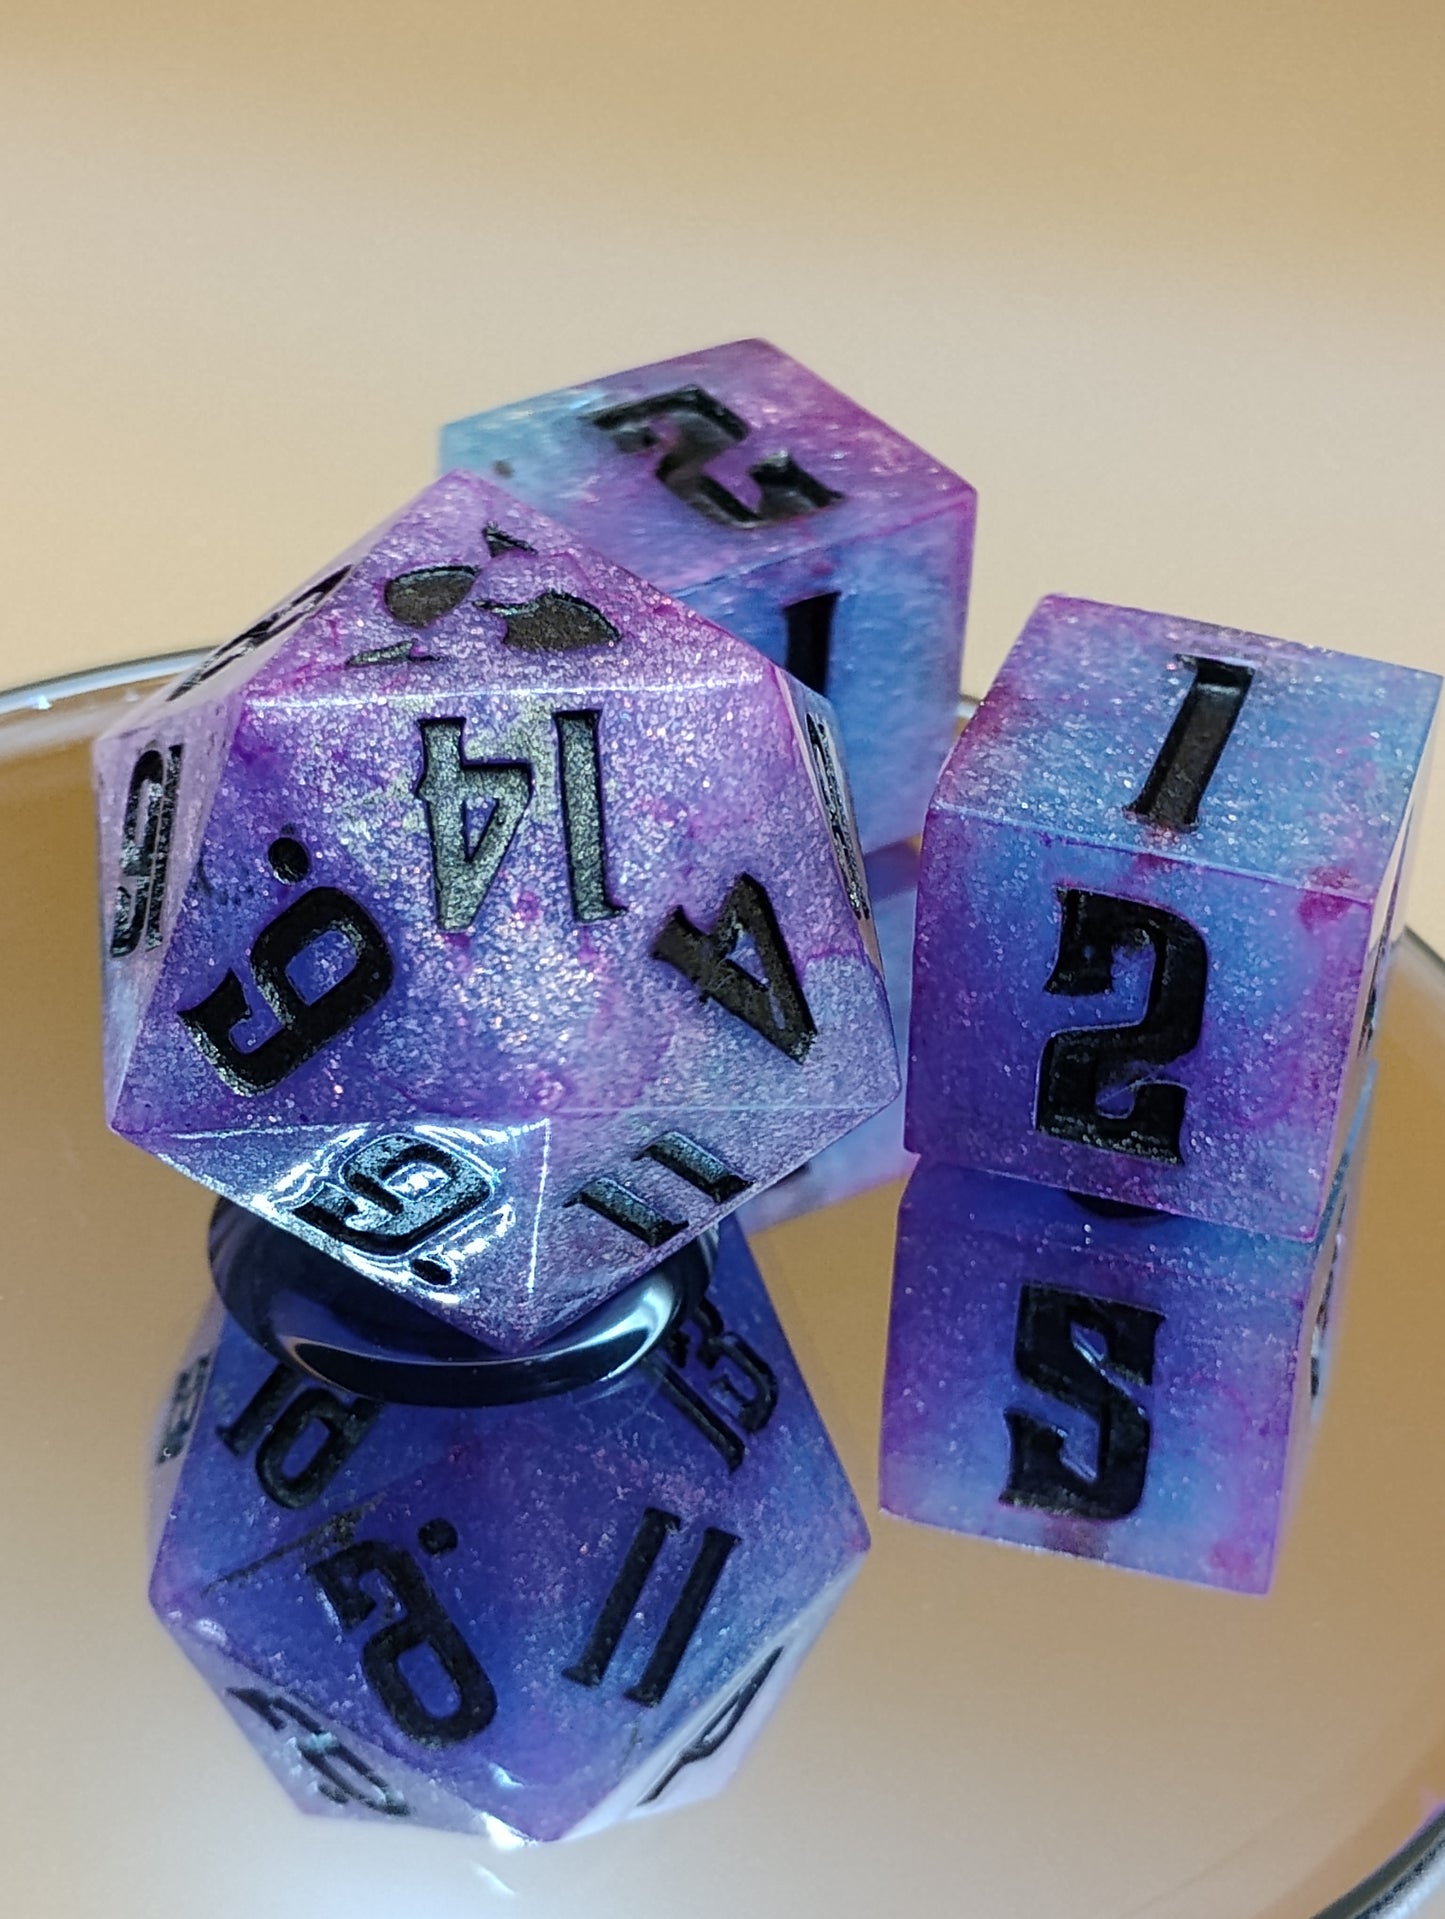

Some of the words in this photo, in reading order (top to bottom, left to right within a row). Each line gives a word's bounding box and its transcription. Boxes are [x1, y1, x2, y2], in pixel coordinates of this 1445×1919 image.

[578, 384, 848, 528] 2
[415, 707, 630, 933] 14
[1122, 653, 1256, 834] 1
[1030, 884, 1208, 1166] 2
